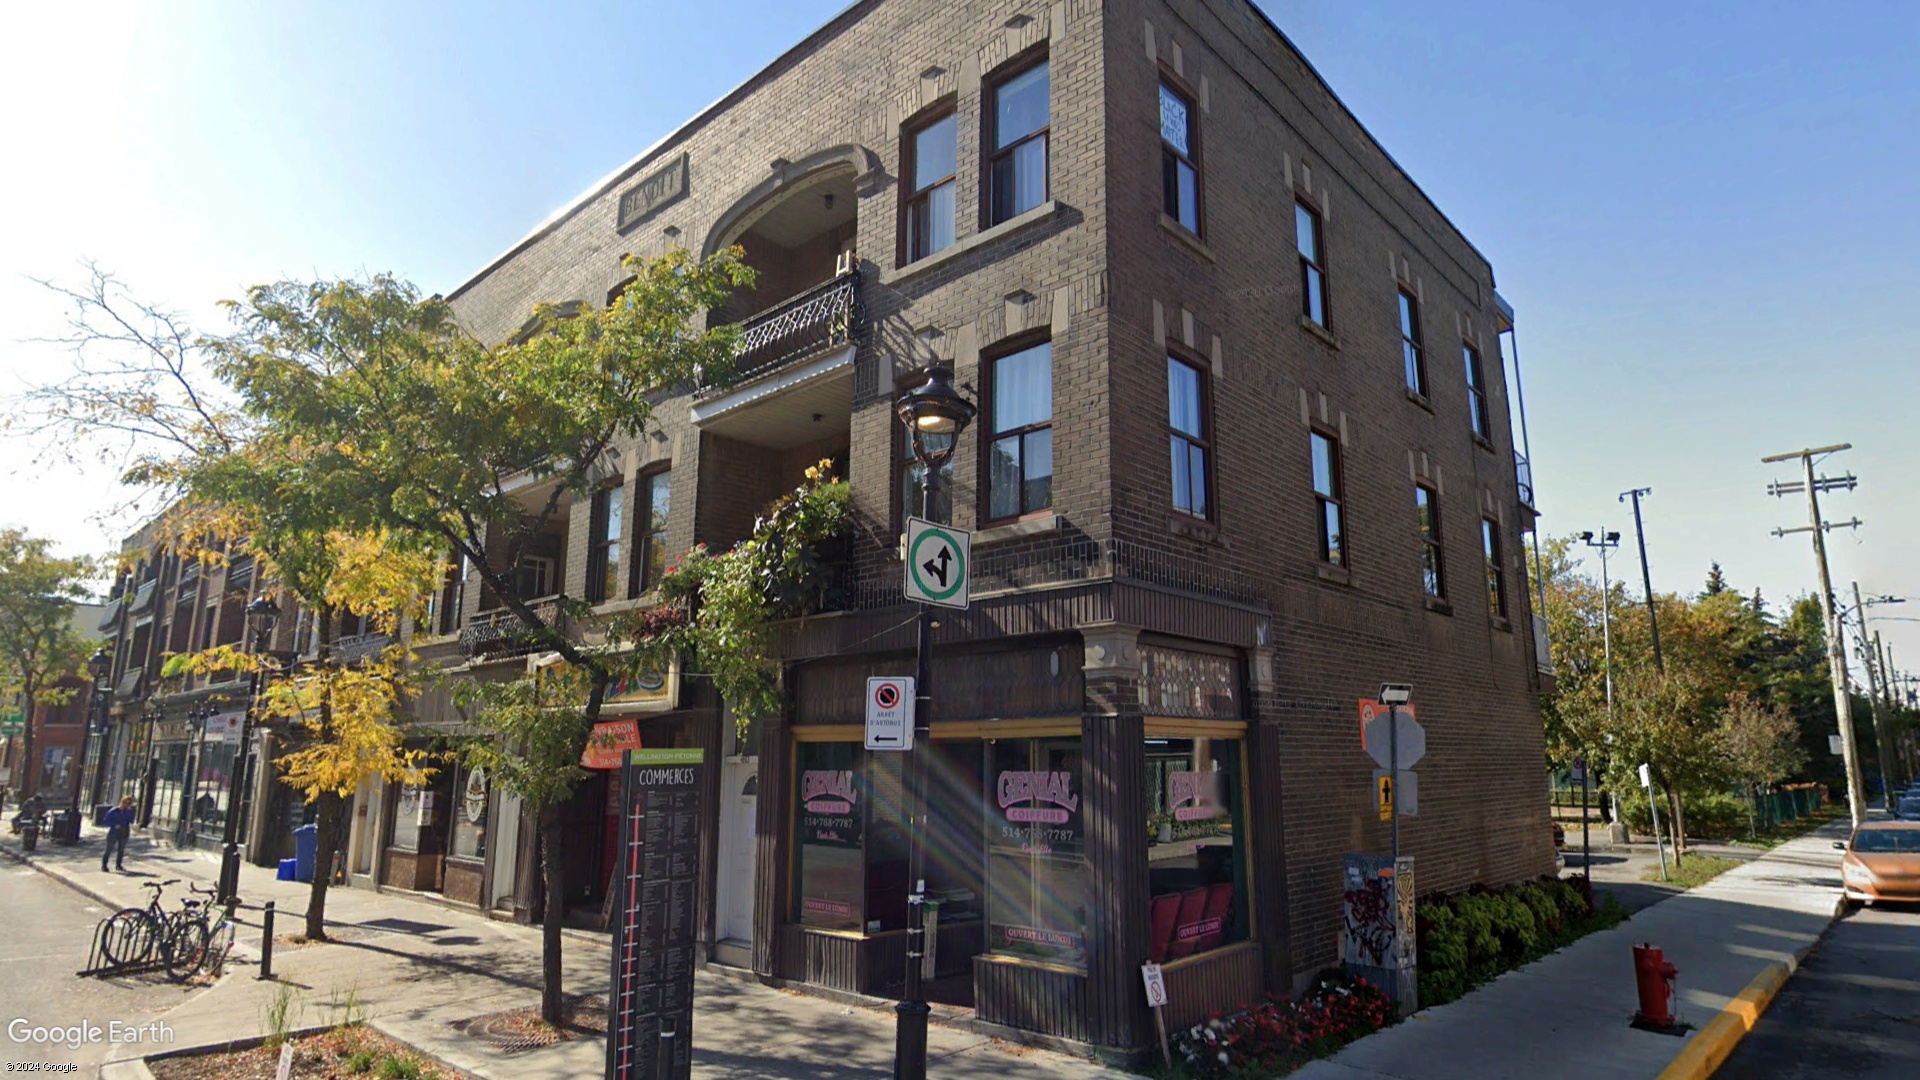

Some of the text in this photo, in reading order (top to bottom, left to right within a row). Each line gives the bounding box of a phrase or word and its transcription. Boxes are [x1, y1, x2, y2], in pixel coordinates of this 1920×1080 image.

[876, 710, 895, 718] ARRÊT
[639, 767, 694, 785] COMMERCES
[801, 769, 857, 804] GENIAL
[997, 770, 1078, 813] GENIAL
[1011, 809, 1064, 820] COIFFURE
[1008, 928, 1072, 945] OUVERT LE LUNDI
[1179, 925, 1199, 938] OUVERT
